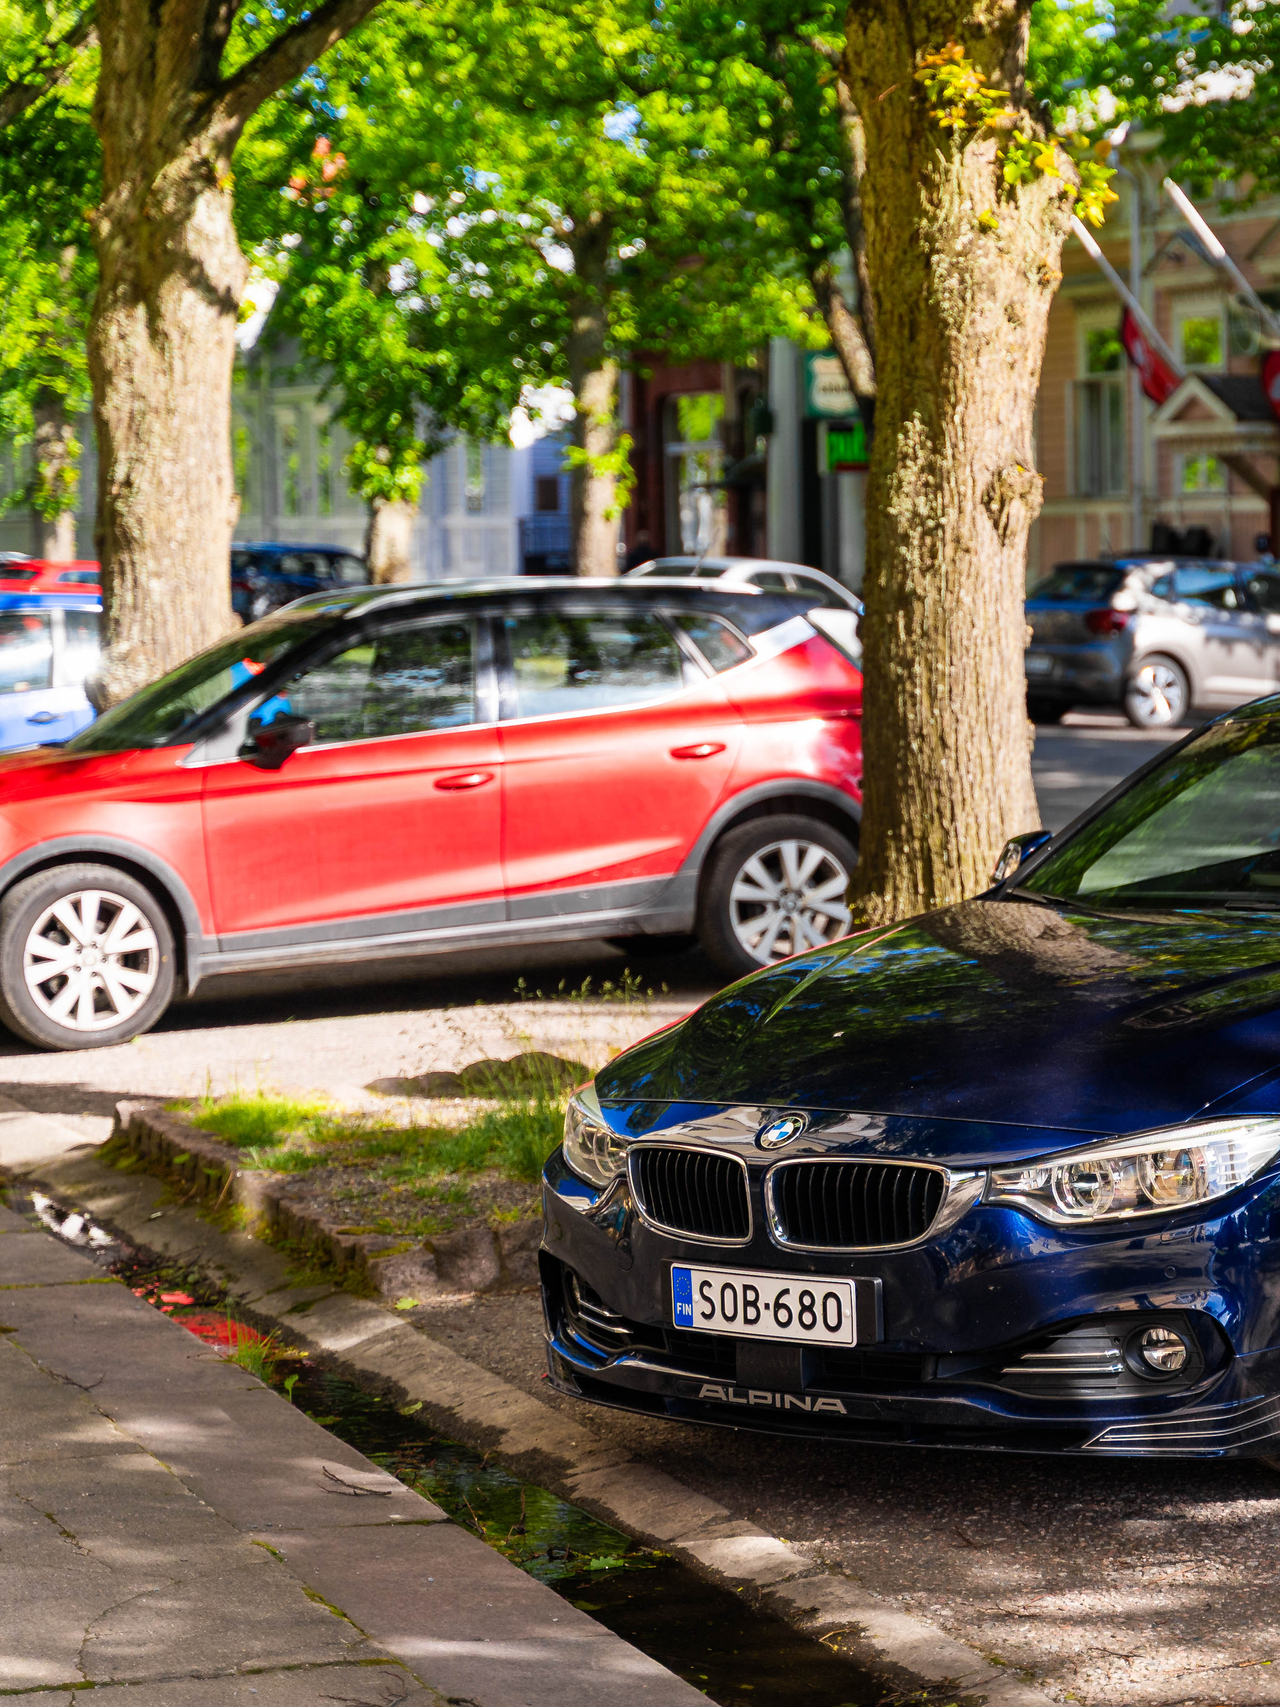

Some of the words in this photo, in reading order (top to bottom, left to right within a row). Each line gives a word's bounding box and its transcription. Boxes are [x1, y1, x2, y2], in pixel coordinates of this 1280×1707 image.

[676, 1302, 692, 1316] FIN
[699, 1279, 843, 1333] SOB-680
[699, 1384, 848, 1415] ALPINA
